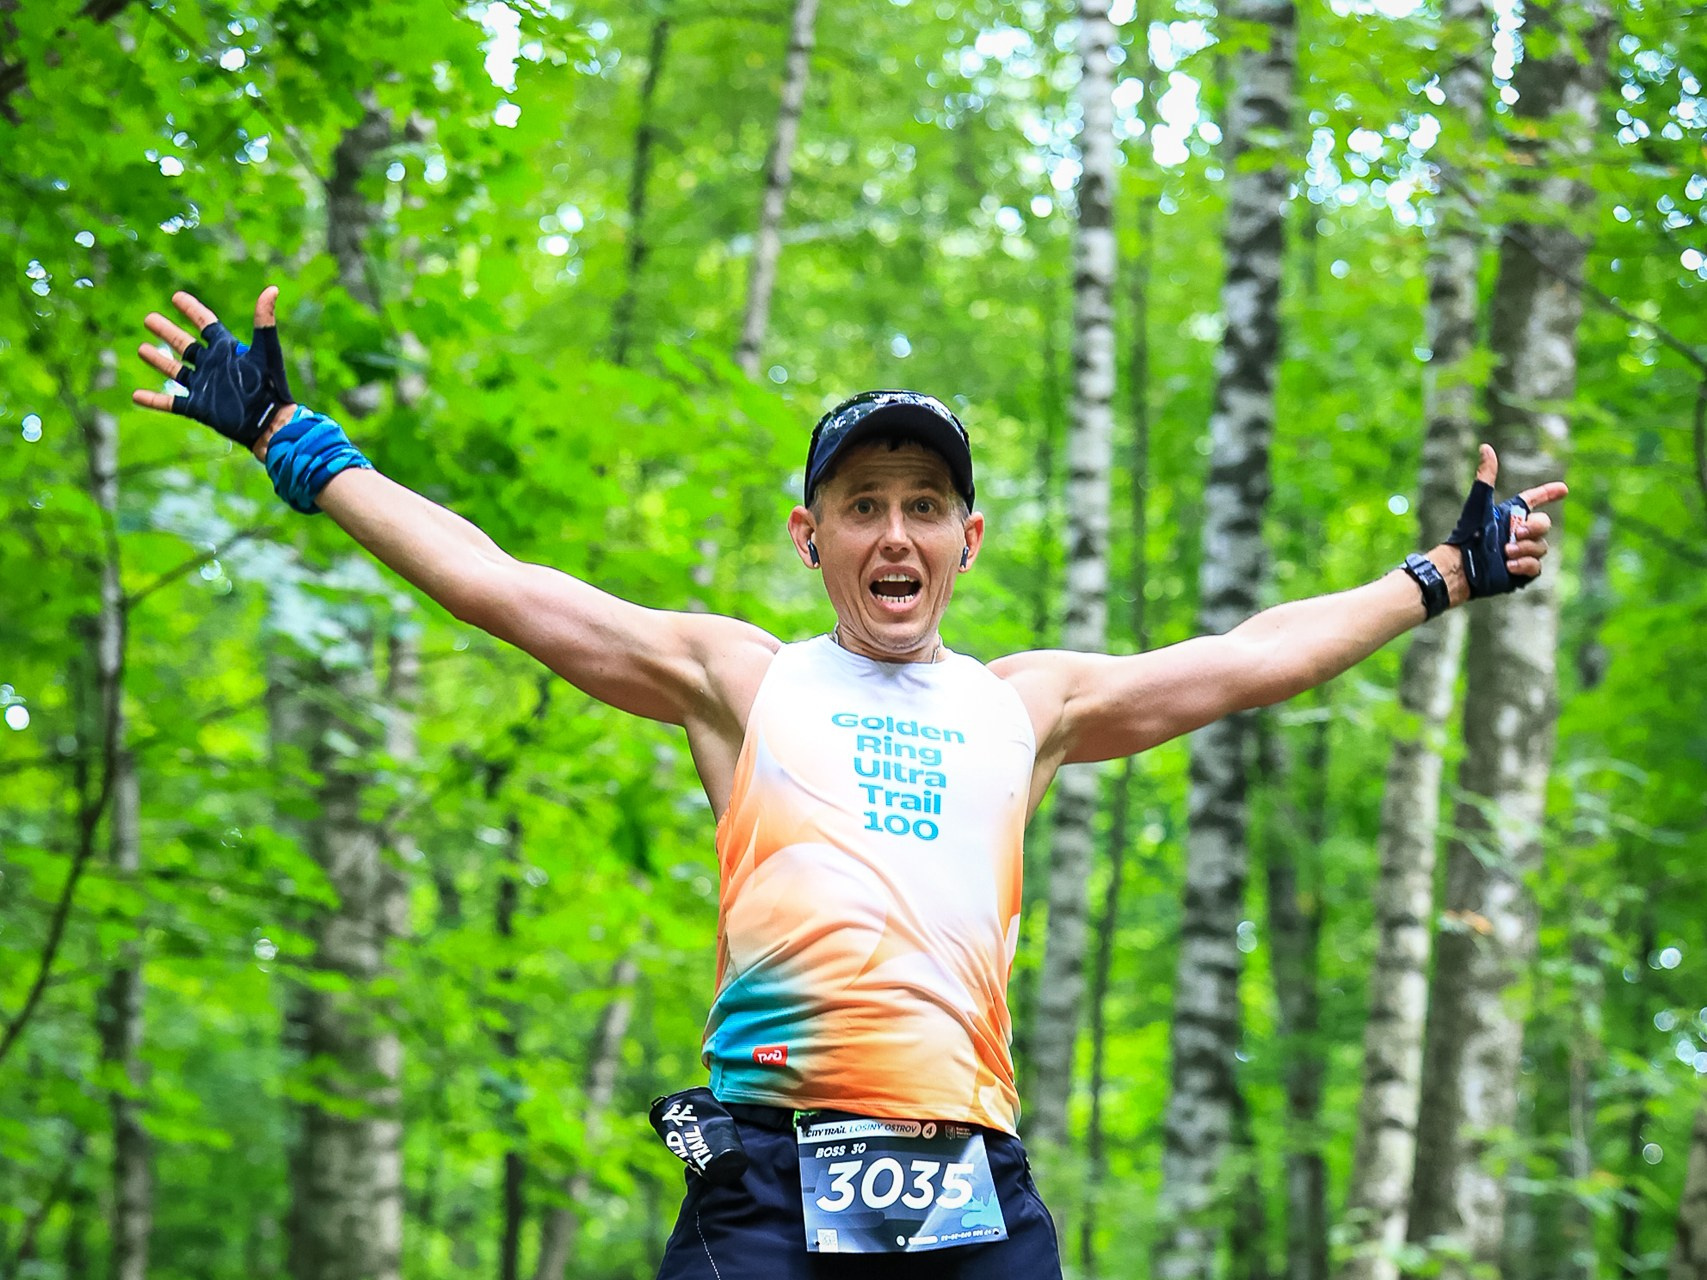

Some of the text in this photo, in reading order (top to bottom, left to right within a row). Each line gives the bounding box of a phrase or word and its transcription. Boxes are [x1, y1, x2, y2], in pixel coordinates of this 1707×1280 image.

[831, 713, 965, 744] Golden
[857, 734, 942, 766] Ring
[854, 757, 947, 788] Ultra
[859, 783, 941, 815] Trail
[863, 811, 939, 841] 100
[849, 1123, 883, 1133] LOSINY
[884, 1123, 917, 1133] OSTROV
[684, 1125, 713, 1171] TRAIL
[815, 1142, 867, 1159] BOSS 30
[815, 1157, 975, 1212] 3035
